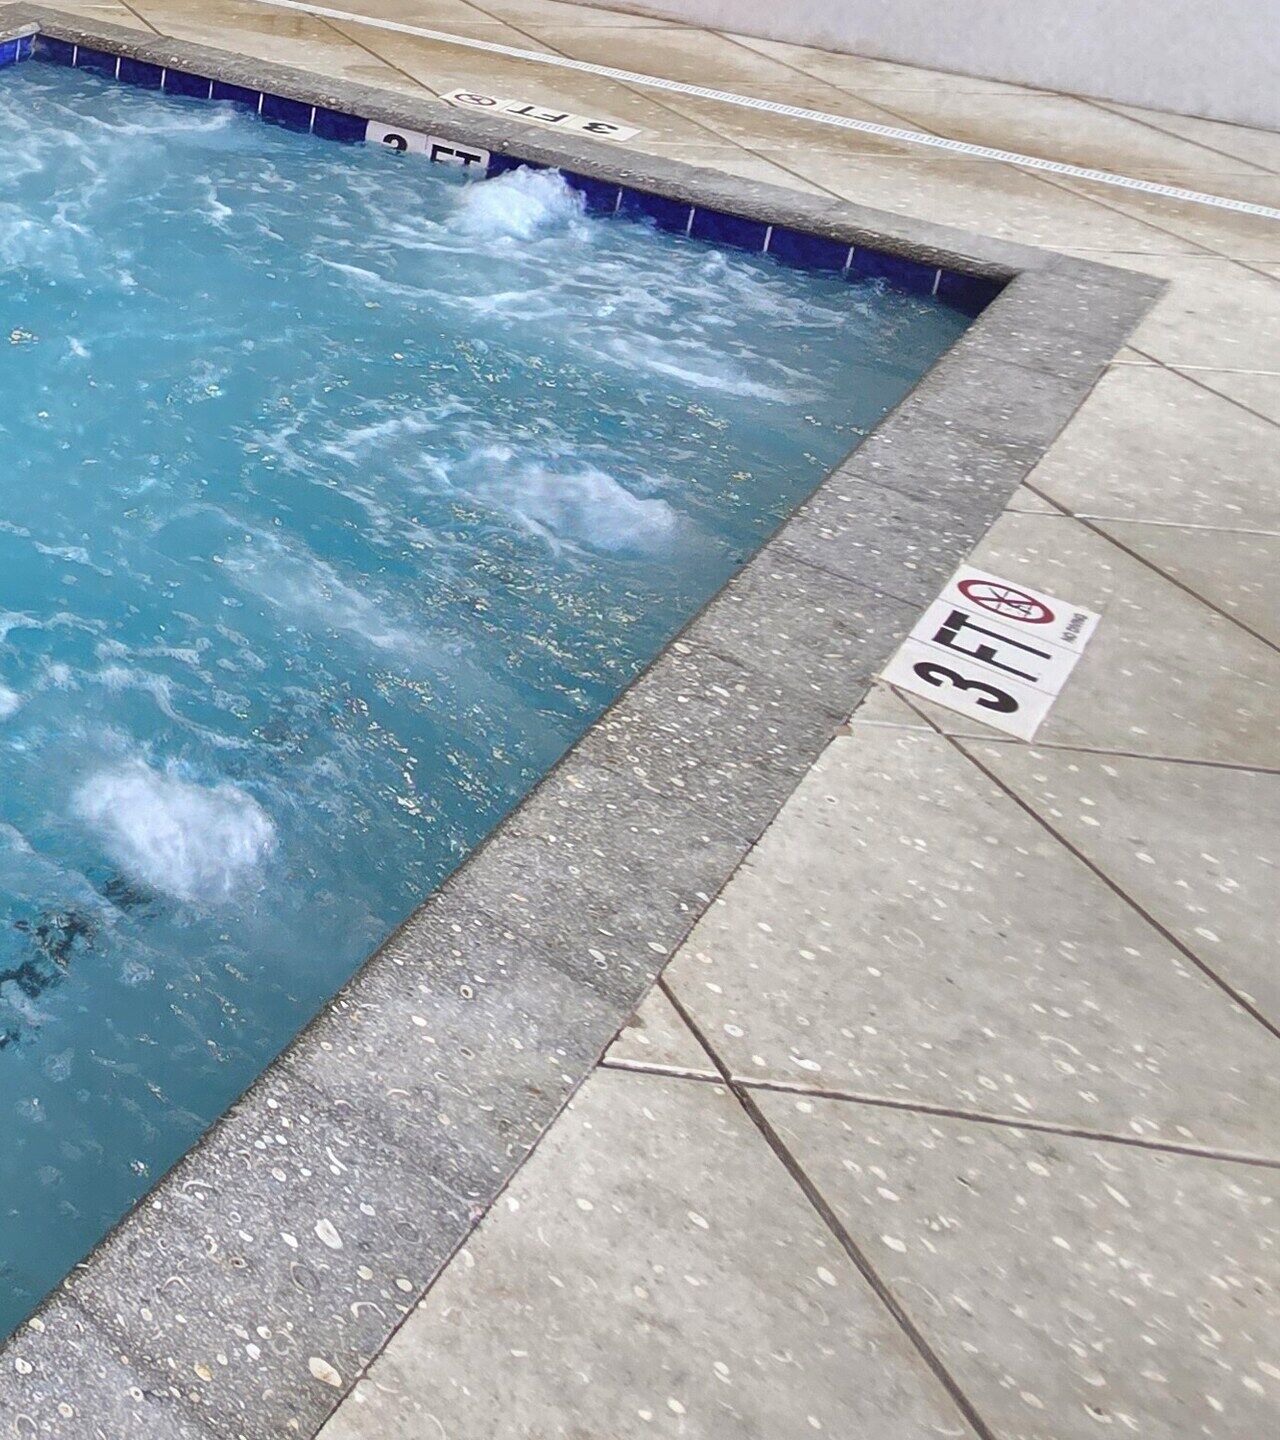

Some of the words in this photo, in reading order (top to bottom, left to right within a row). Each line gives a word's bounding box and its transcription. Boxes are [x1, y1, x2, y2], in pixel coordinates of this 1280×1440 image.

[506, 105, 570, 123] FT
[582, 121, 619, 135] 3
[1065, 613, 1089, 634] DIVING
[932, 610, 1052, 683] FT
[1060, 631, 1077, 645] NO
[913, 661, 1019, 714] 3
